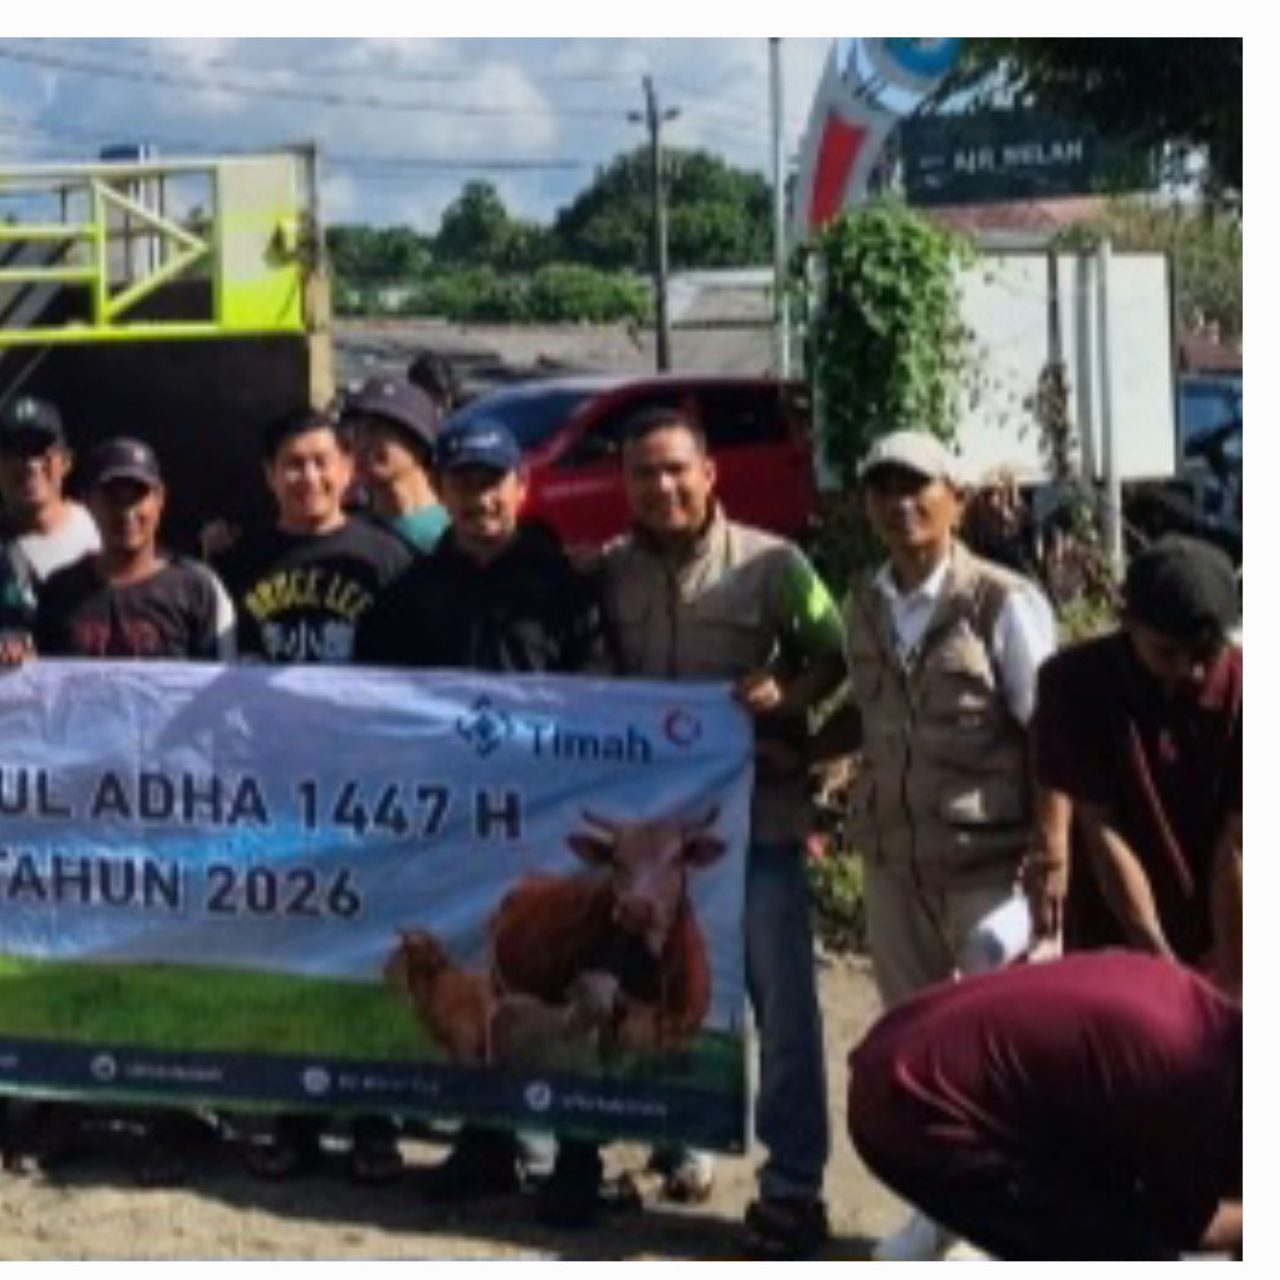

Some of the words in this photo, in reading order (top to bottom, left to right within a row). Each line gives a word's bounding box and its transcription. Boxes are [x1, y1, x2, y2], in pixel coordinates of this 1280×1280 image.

[91, 769, 269, 827] ADHA
[298, 780, 450, 838] 1447
[477, 791, 520, 840] H
[207, 864, 362, 918] 2026
